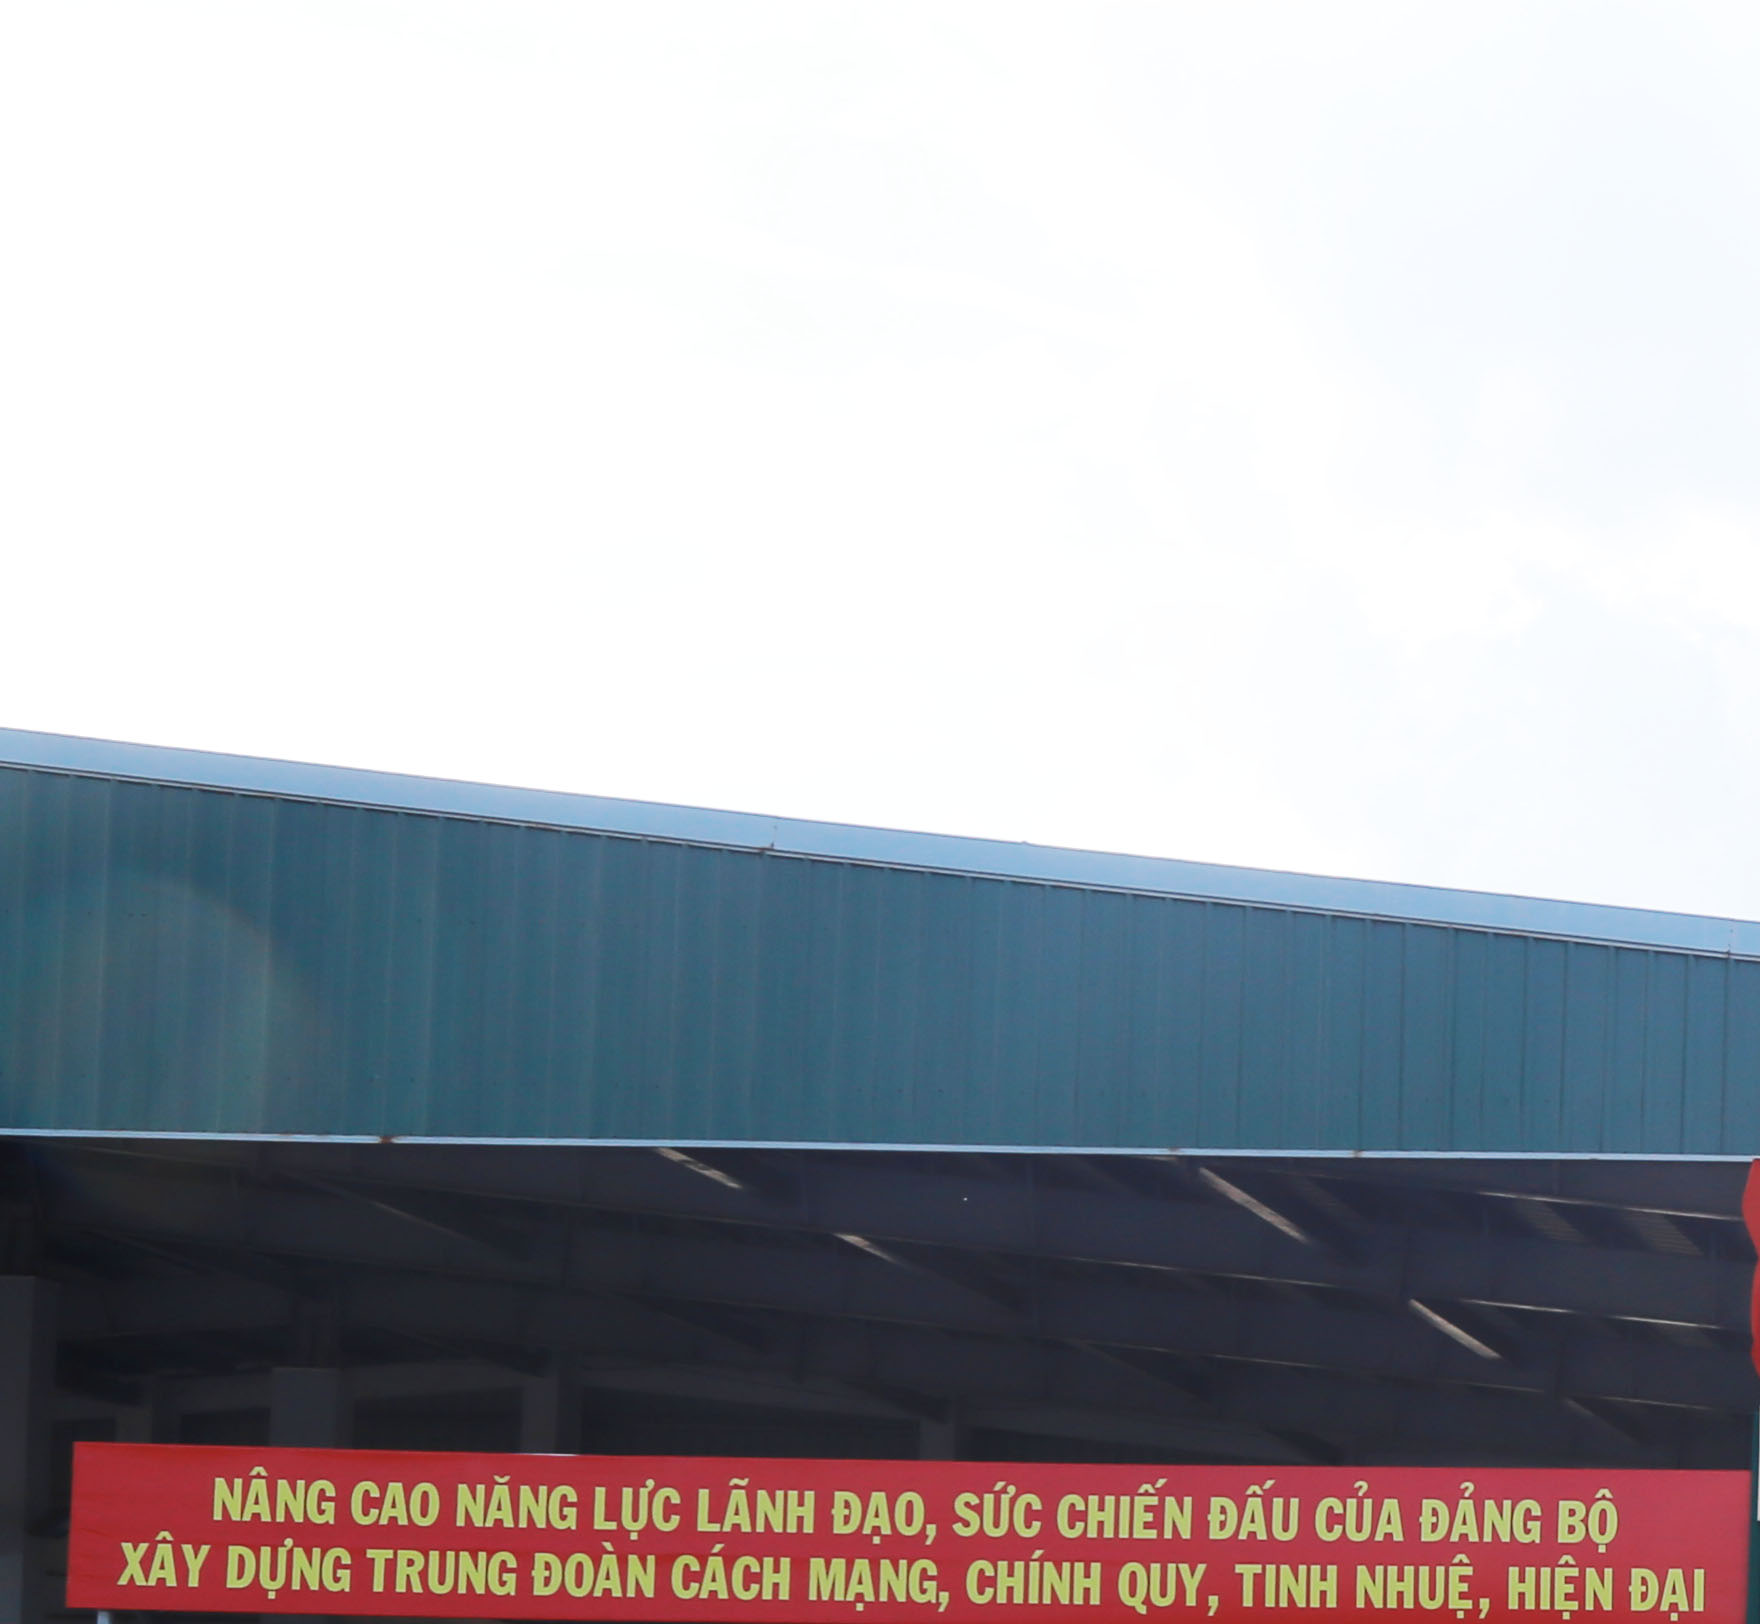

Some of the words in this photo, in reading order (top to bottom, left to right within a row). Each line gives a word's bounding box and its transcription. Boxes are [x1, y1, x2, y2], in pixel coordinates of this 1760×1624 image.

[212, 1466, 336, 1524] NÂNG
[351, 1481, 441, 1527] CAO
[456, 1476, 578, 1529] NĂNG
[593, 1479, 681, 1542] LỰC
[697, 1478, 815, 1533] LÃNH
[831, 1491, 937, 1545] ĐẠO,
[954, 1483, 1042, 1537] SỨC
[1057, 1479, 1193, 1539] CHIẾN
[1208, 1480, 1299, 1541] ĐẤU
[1315, 1482, 1404, 1542] CỦA
[1420, 1483, 1542, 1543] ĐẢNG
[1557, 1489, 1619, 1553] BỘ
[118, 1530, 211, 1588] XÂY
[226, 1538, 352, 1599] DỰNG
[366, 1548, 518, 1596] TRUNG
[531, 1545, 656, 1598] ĐOÀN
[671, 1543, 791, 1601] CÁCH
[809, 1557, 950, 1612] MẠNG,
[965, 1550, 1102, 1605] CHÍNH
[1117, 1562, 1219, 1615] QUY,
[1235, 1564, 1338, 1609] TINH
[1355, 1554, 1490, 1619] NHUỆ,
[1508, 1556, 1613, 1620] HIỆN
[1629, 1568, 1705, 1621] ĐẠI
